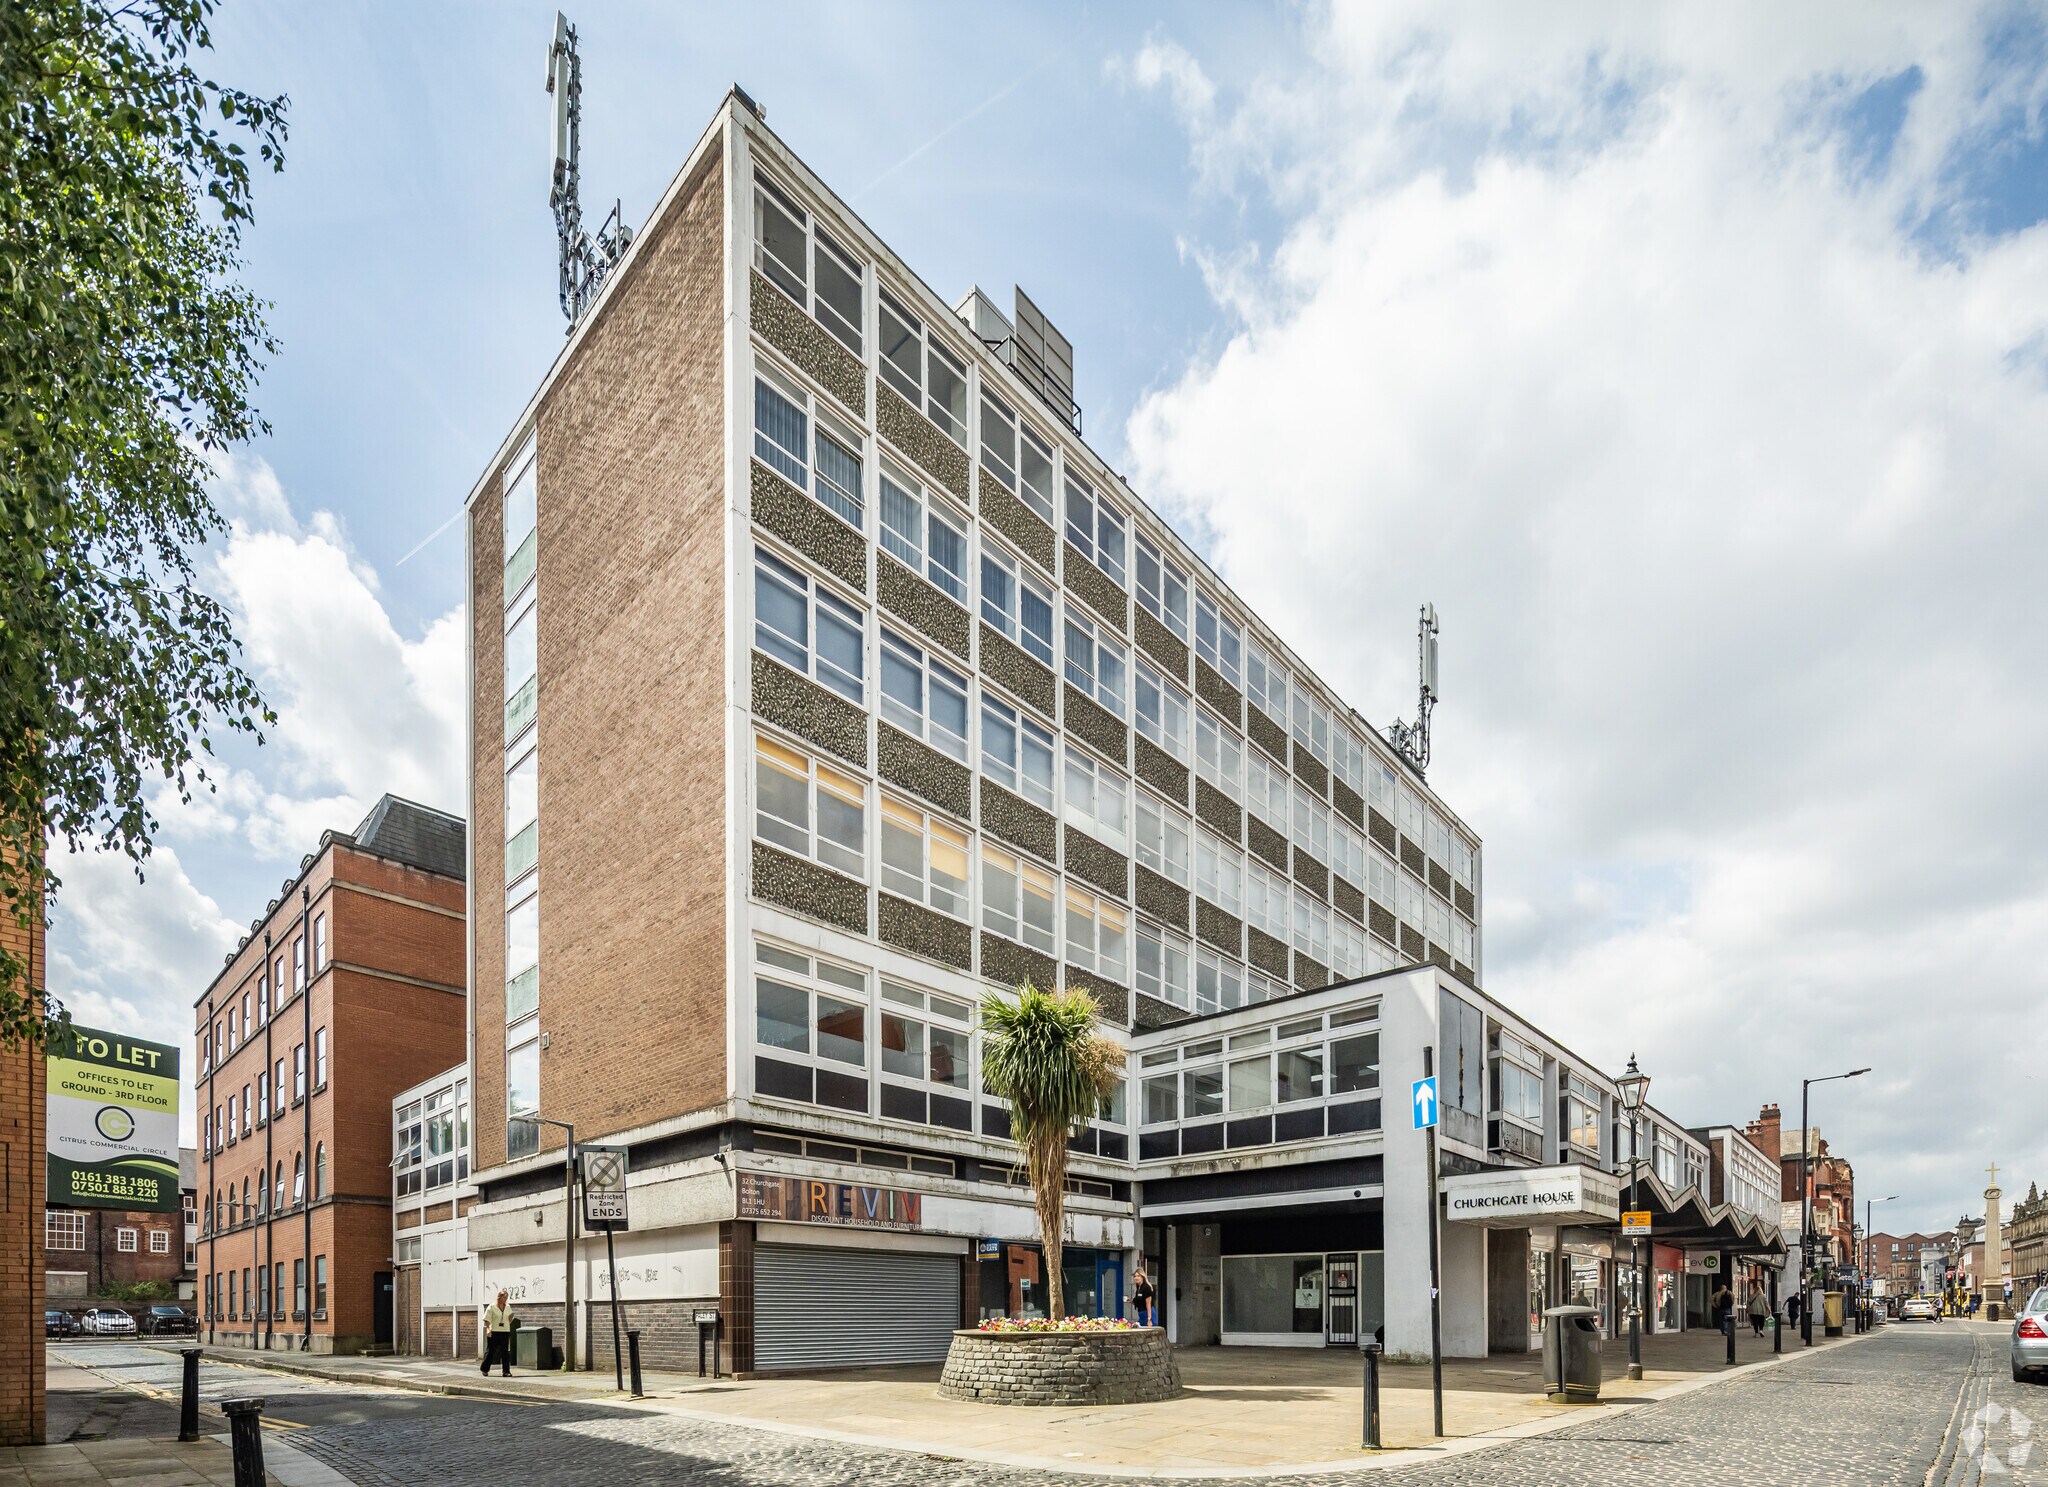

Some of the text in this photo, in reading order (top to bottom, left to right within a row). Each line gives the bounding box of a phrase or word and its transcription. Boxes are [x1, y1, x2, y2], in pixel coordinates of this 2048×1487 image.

[76, 1036, 161, 1068] TO LET
[77, 1071, 154, 1091] OFFICES TO LET
[61, 1081, 106, 1095] GROUND
[115, 1090, 134, 1100] 3RD
[136, 1094, 168, 1106] FLOOR
[59, 1136, 168, 1156] CITRUS COMMERCIAL CIRCLE
[71, 1170, 158, 1189] 0161 383 1806
[741, 1177, 749, 1185] 32
[71, 1180, 159, 1198] 07501 883 220
[741, 1187, 760, 1196] Bolton
[741, 1197, 766, 1206] BL1 1HU
[811, 1181, 920, 1222] REVIV
[1454, 1194, 1528, 1209] CHURCHGATE
[1533, 1190, 1575, 1205] HOUSE
[592, 1208, 622, 1217] ENDS
[741, 1207, 782, 1217] 07375 652 294
[811, 1214, 843, 1225] DISCOUNT
[845, 1218, 880, 1228] HOUSEHOLD
[881, 1221, 893, 1229] AND
